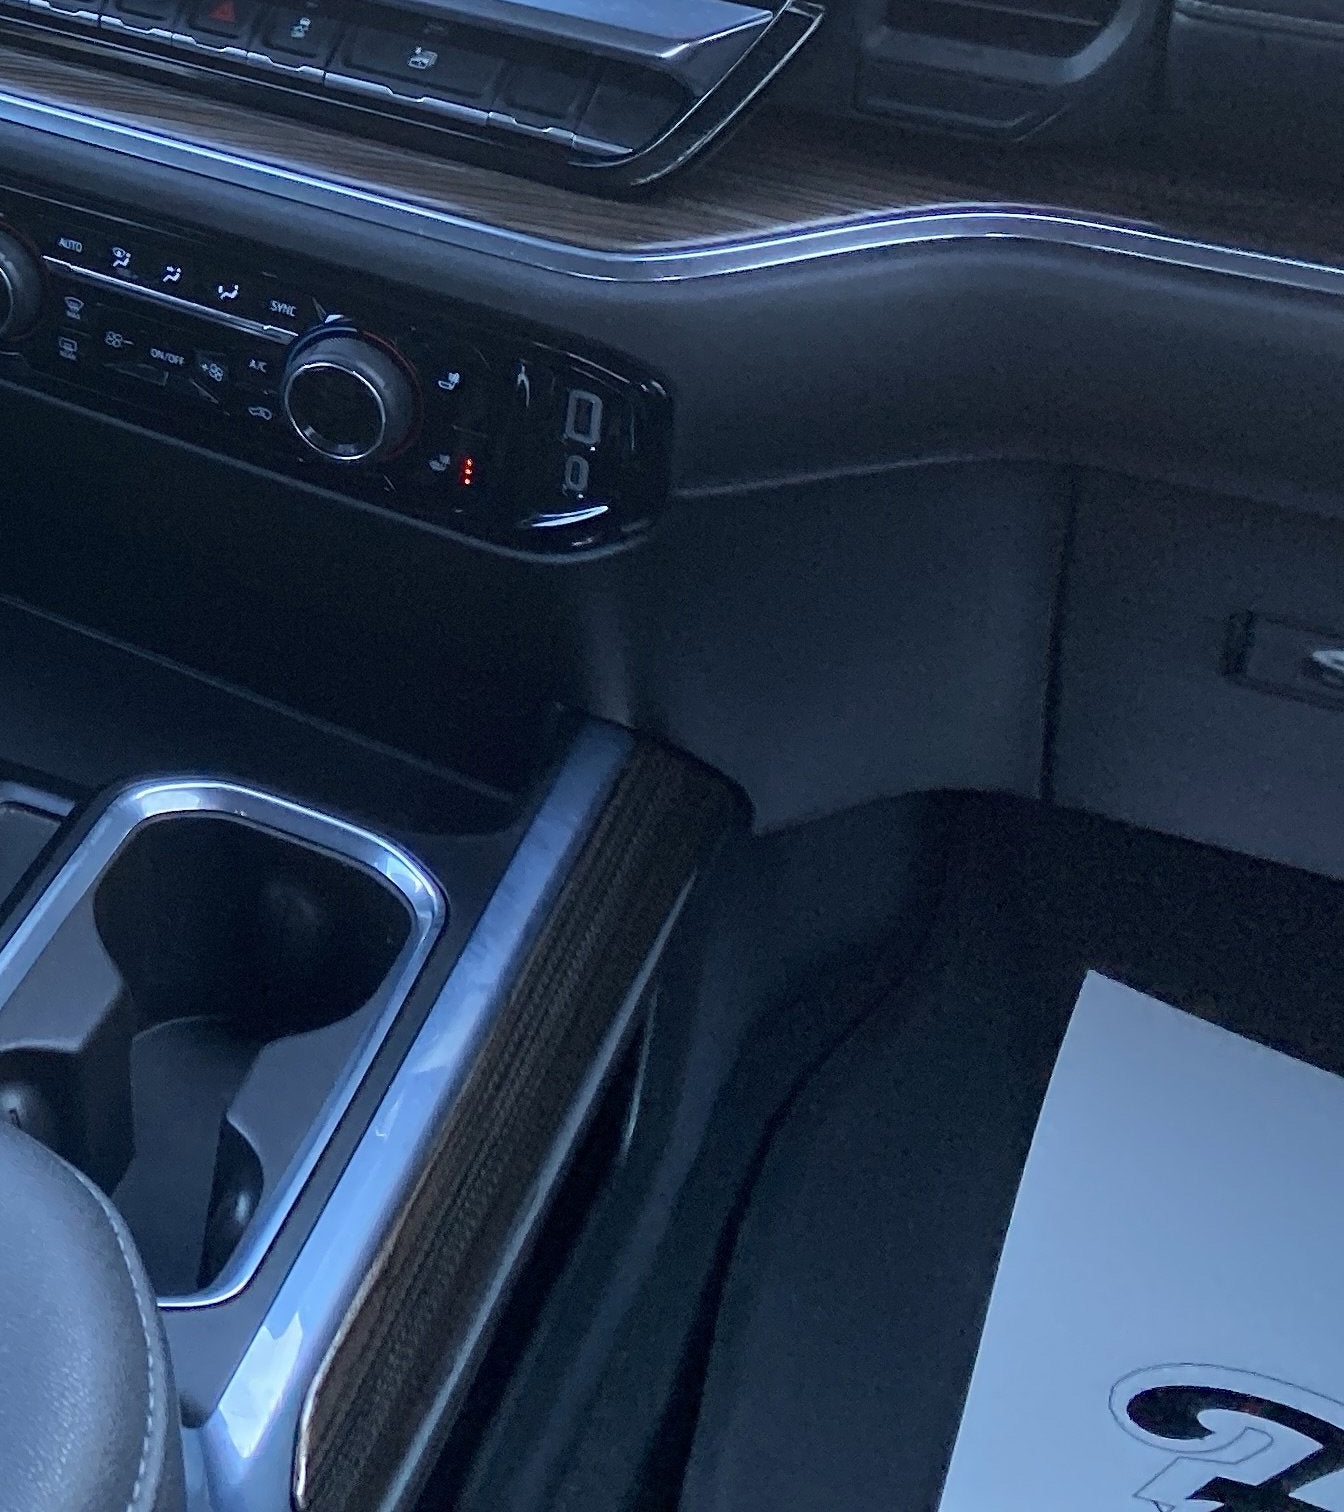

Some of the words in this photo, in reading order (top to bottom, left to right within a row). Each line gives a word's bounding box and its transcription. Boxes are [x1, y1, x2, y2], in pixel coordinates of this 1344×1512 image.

[58, 237, 83, 253] AUTO
[269, 300, 297, 317] SYNC
[149, 347, 185, 365] ON/OFF
[248, 358, 267, 373] A/C
